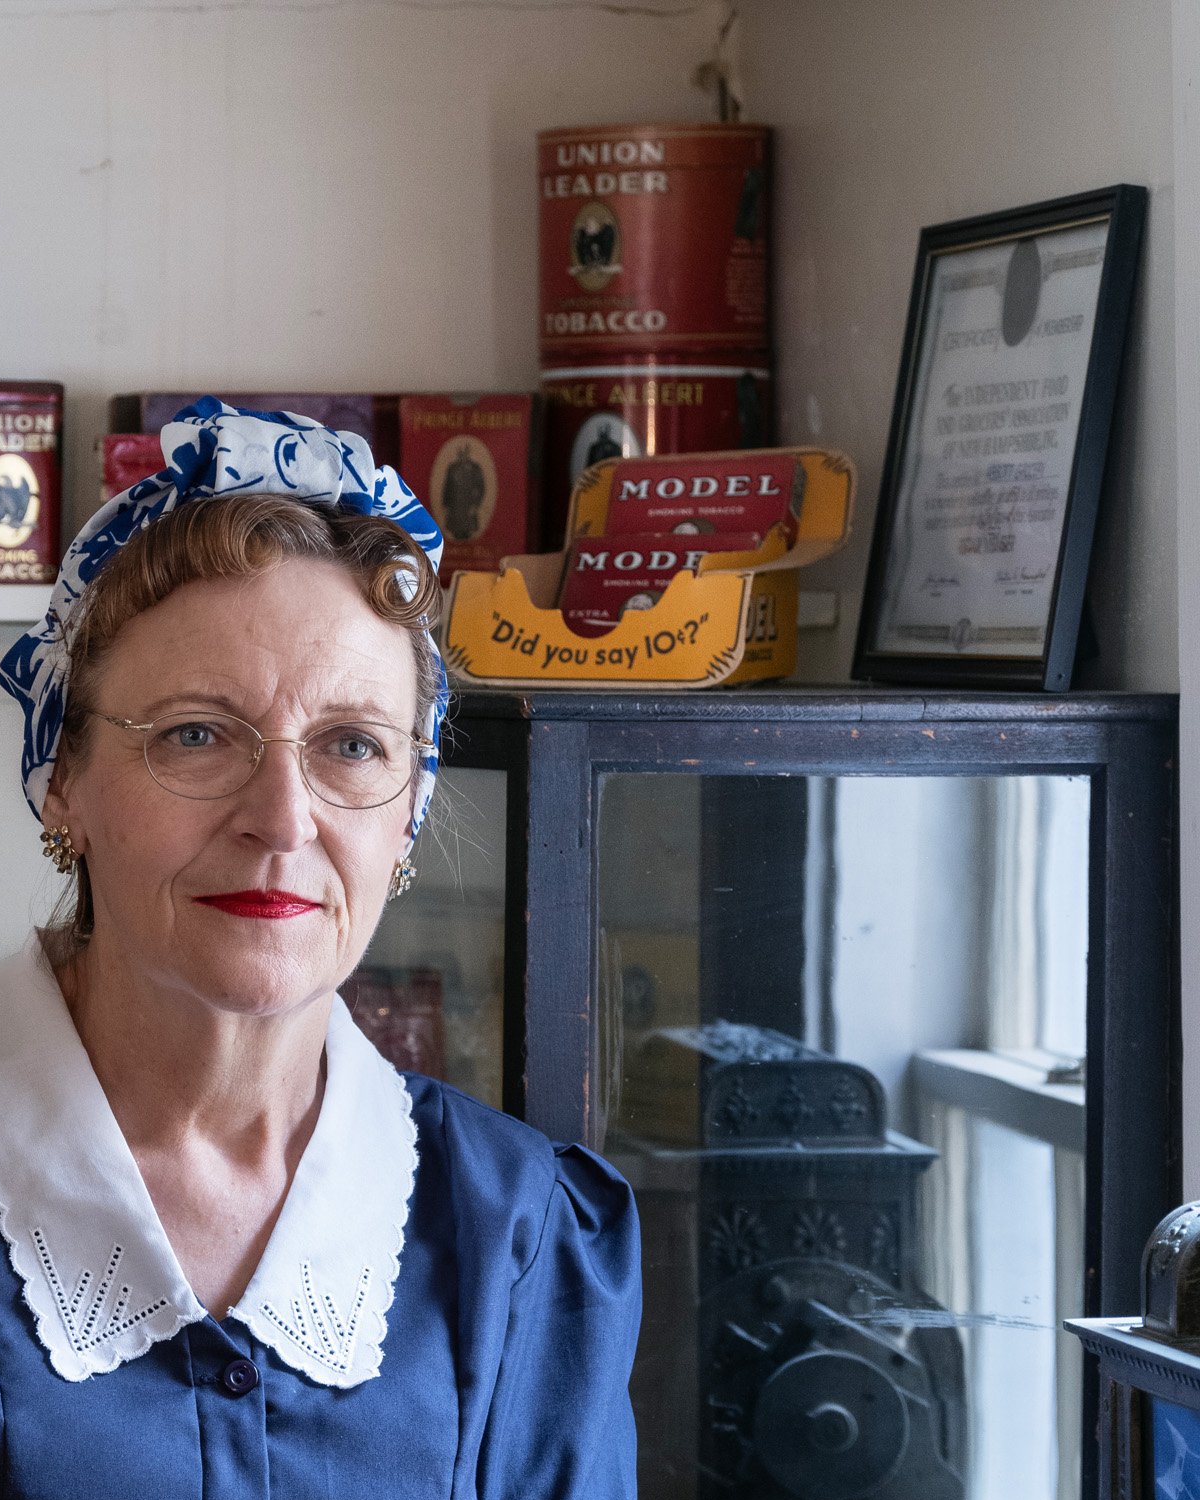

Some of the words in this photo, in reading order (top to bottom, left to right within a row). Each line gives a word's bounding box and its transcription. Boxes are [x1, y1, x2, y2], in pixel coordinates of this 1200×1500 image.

[556, 140, 666, 168] UNION
[543, 170, 668, 198] LEADER
[546, 308, 668, 335] TOBACCO
[608, 381, 705, 406] ALBERT
[618, 473, 781, 502] MODEL
[648, 507, 693, 517] SMOKING
[698, 505, 746, 516] TOBACCO
[568, 609, 610, 619] EXTRA
[490, 611, 542, 657] "Did
[542, 642, 589, 670] you
[594, 642, 638, 670] say
